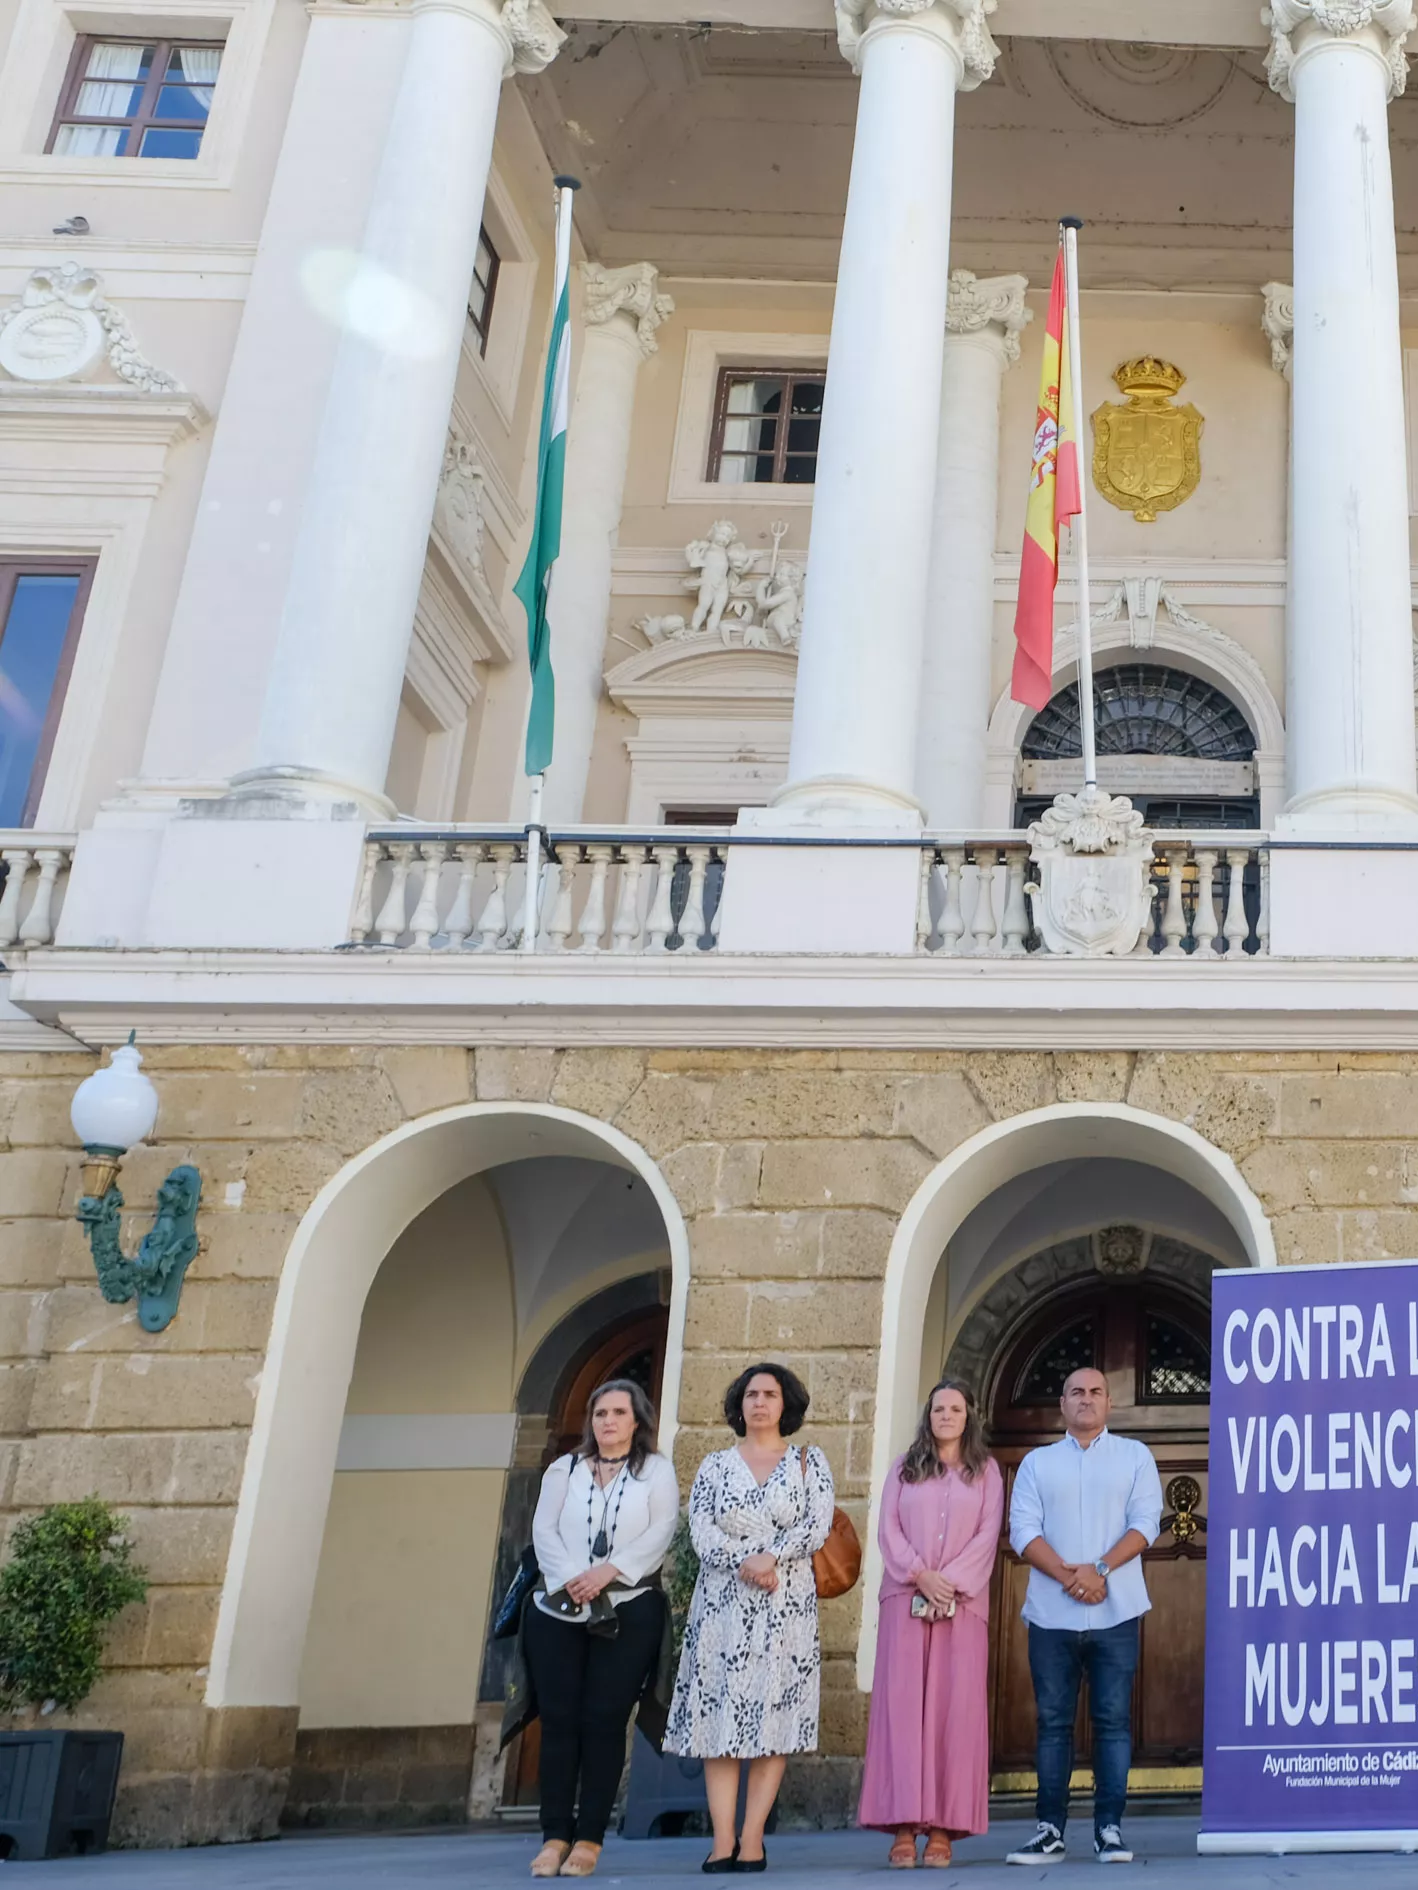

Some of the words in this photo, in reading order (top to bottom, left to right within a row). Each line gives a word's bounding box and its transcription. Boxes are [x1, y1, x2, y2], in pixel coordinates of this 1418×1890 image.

[1222, 1301, 1397, 1386] CONTRA
[1228, 1523, 1364, 1609] HACIA
[1262, 1752, 1359, 1777] Ayuntamiento
[1361, 1751, 1380, 1772] de
[1285, 1775, 1324, 1788] Fundación
[1324, 1775, 1360, 1788] Municipal
[1360, 1775, 1371, 1787] de
[1371, 1774, 1379, 1786] la
[1379, 1774, 1402, 1788] Mujer
